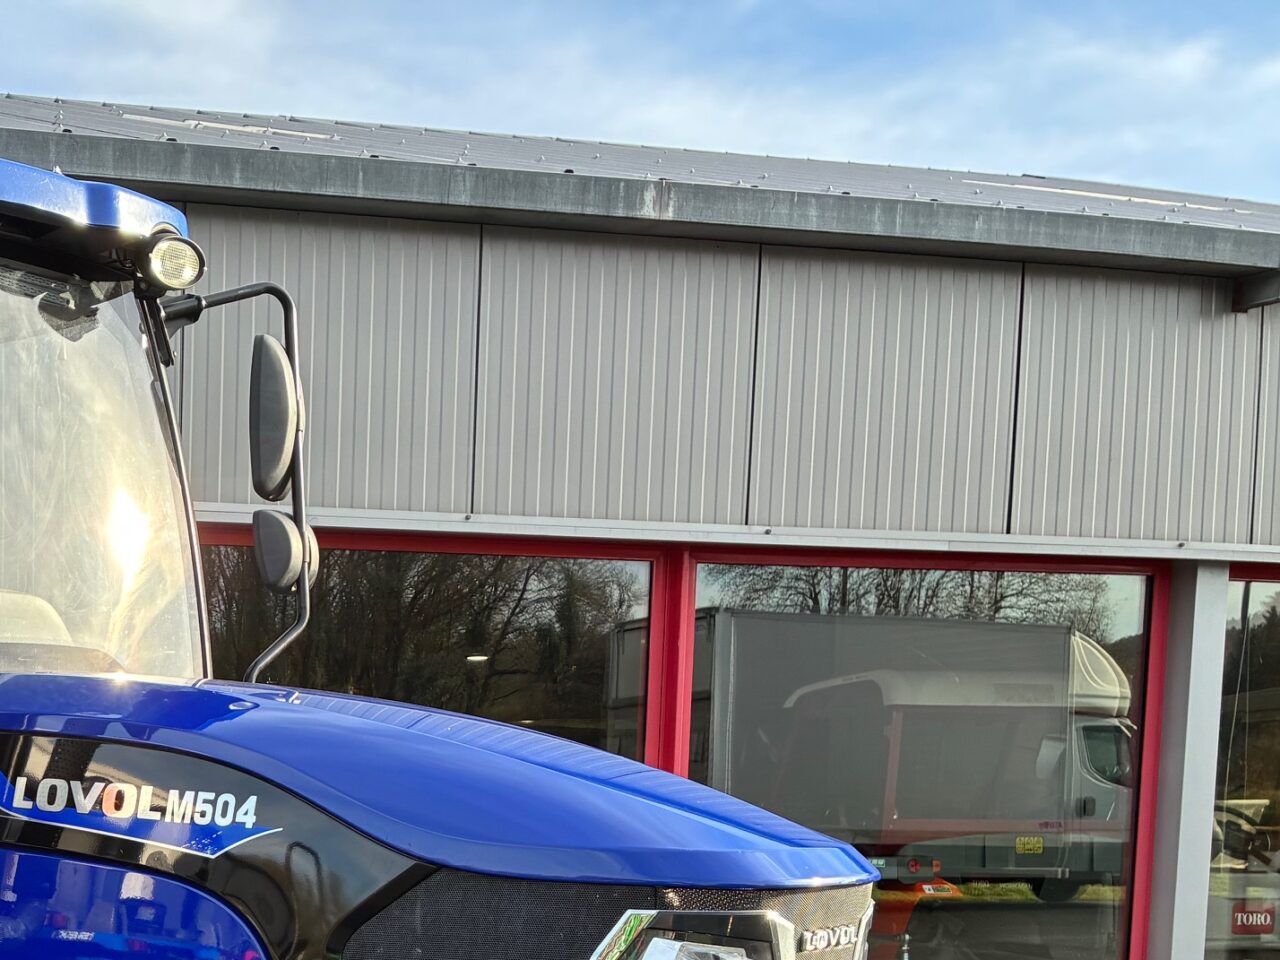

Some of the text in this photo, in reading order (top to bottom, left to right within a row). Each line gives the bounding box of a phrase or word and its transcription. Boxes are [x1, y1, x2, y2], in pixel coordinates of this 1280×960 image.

[12, 776, 163, 820] LOVOL
[1234, 912, 1271, 926] TORO
[801, 924, 858, 952] LOVOL
